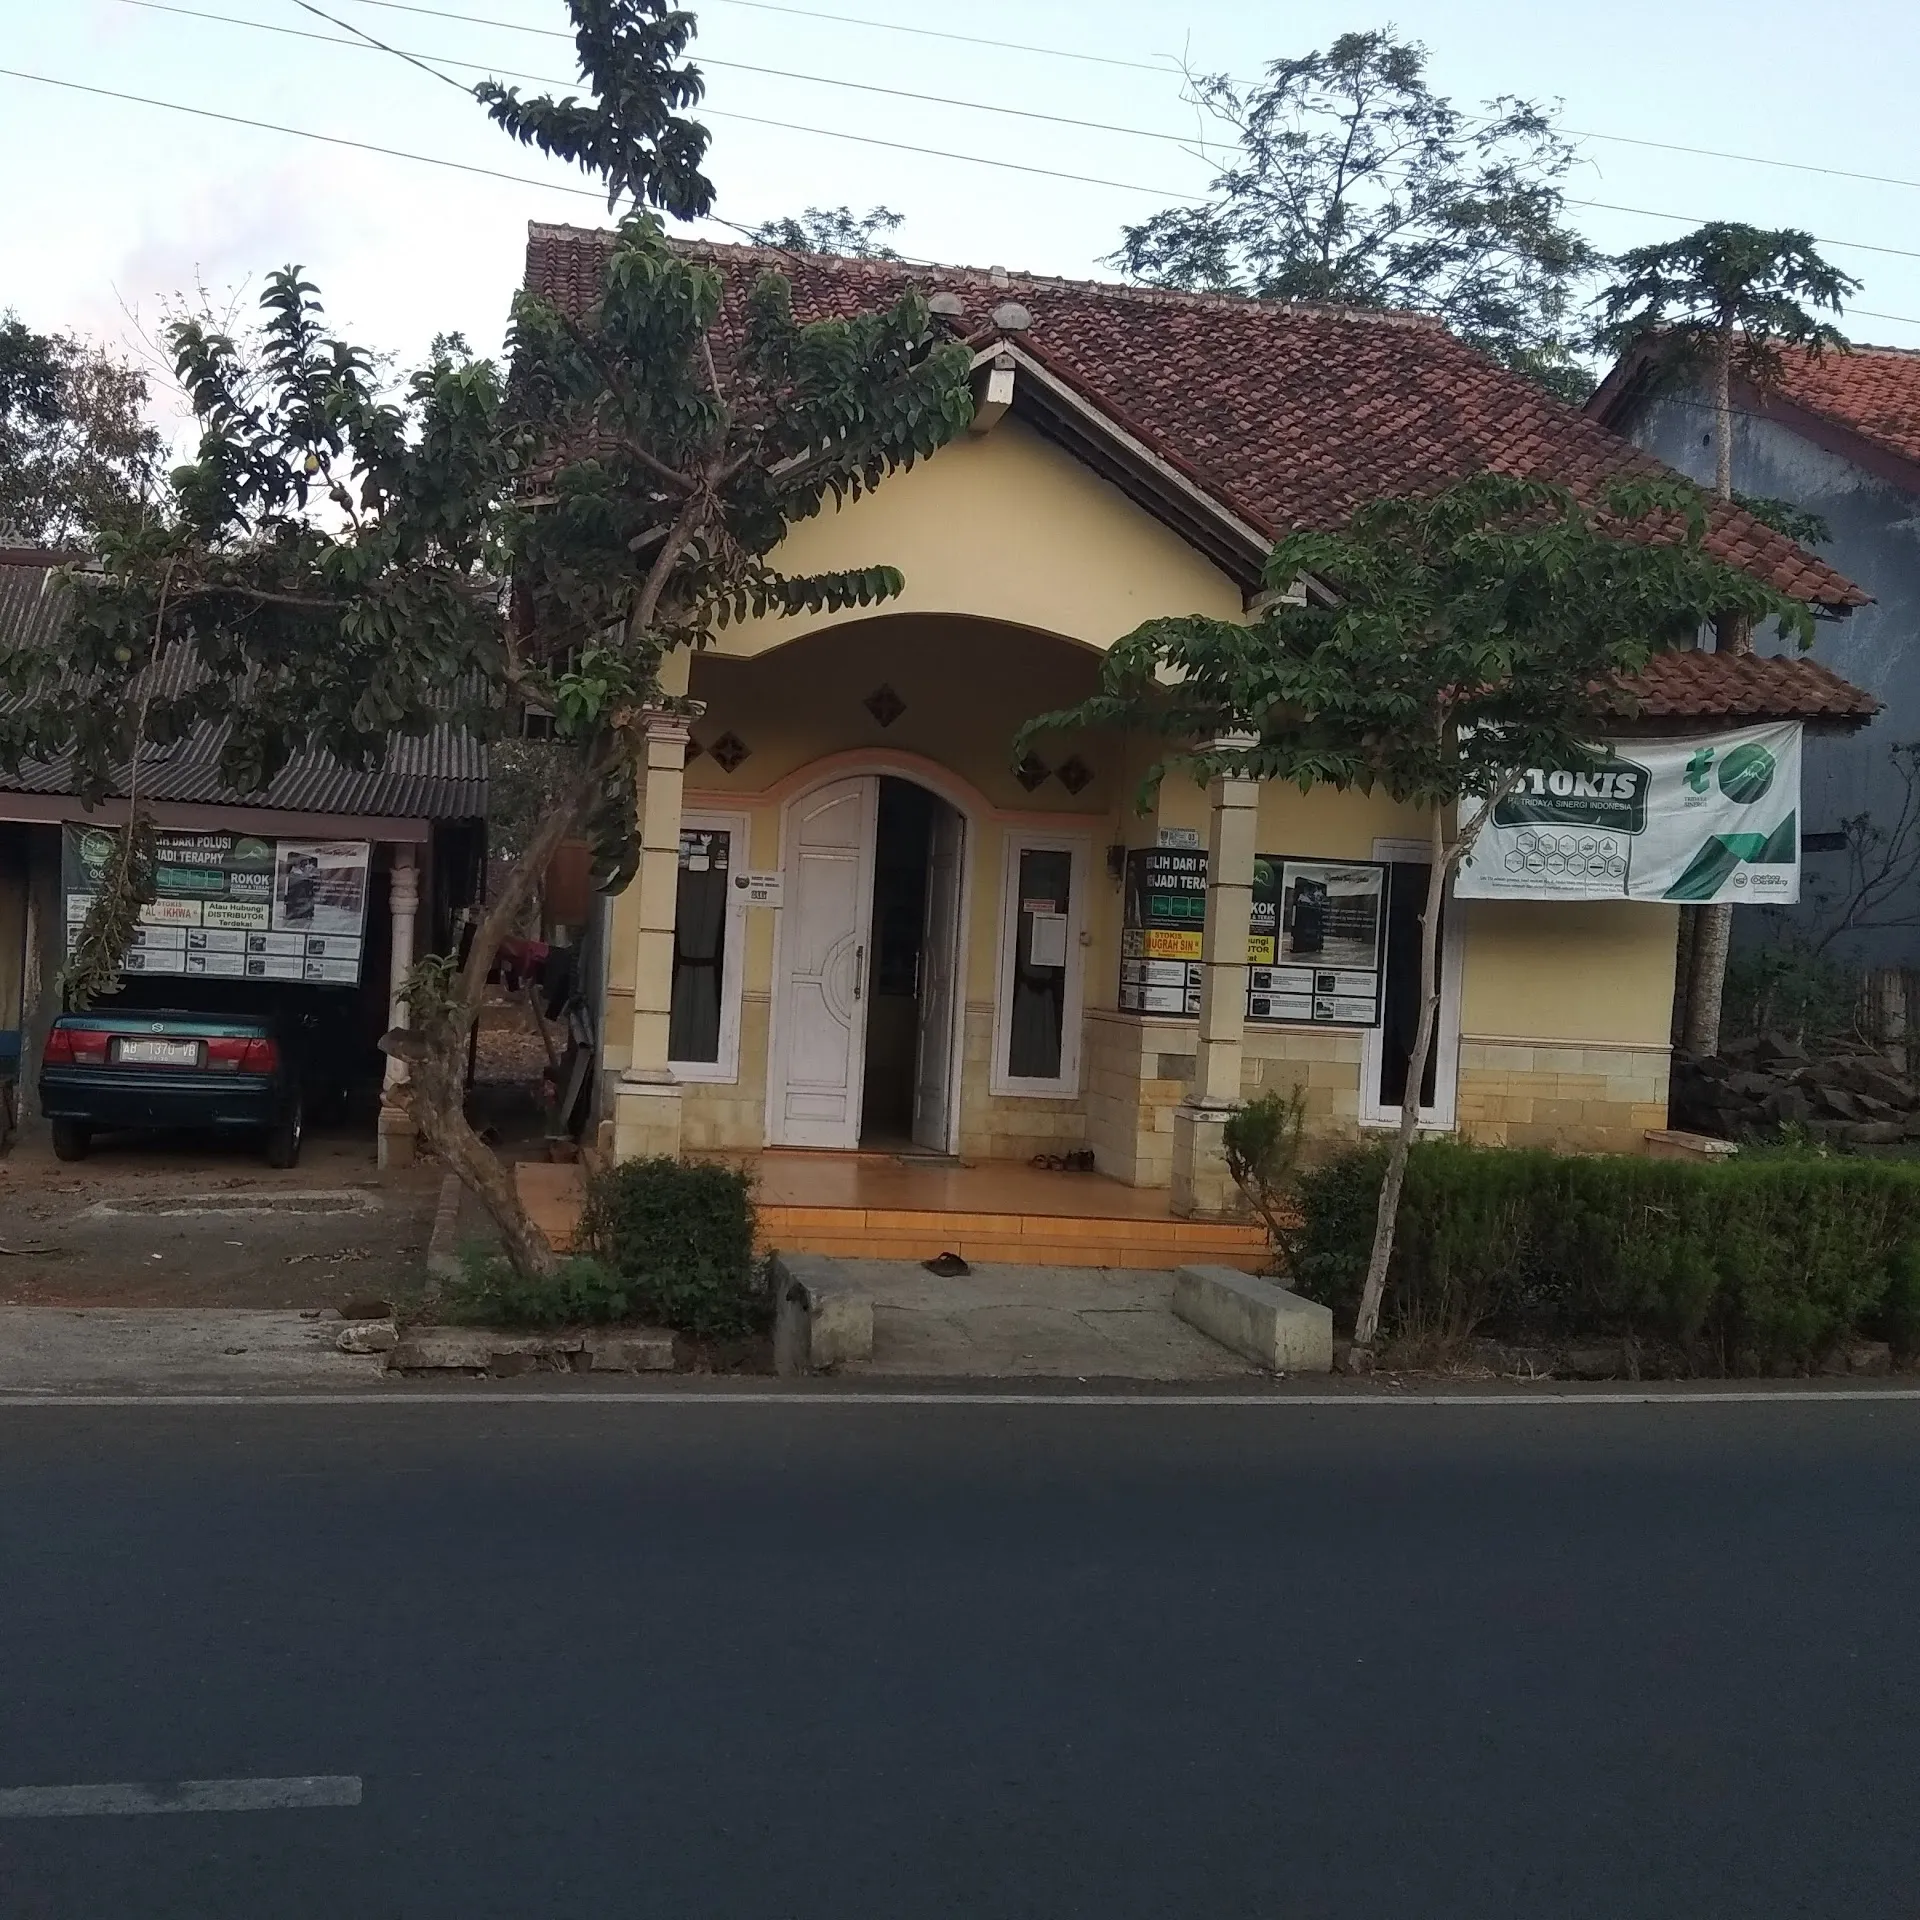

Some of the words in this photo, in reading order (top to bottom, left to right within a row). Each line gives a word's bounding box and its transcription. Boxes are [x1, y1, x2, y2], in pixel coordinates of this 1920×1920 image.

[1520, 798, 1554, 807] TRIDAYA
[1555, 801, 1588, 809] SINERGI
[1589, 802, 1632, 811] INDONESIA
[197, 836, 232, 850] POLUSI
[180, 850, 225, 865] TERAPHY
[1172, 857, 1197, 871] DARI
[230, 873, 270, 886] ROKOK
[1180, 875, 1208, 890] TERA
[230, 904, 264, 913] Hubungi
[207, 911, 264, 921] DISTRIBUTOR
[219, 920, 253, 928] Terdekat
[1154, 931, 1183, 940] STOKIS
[1180, 939, 1194, 951] SIN
[122, 1041, 137, 1054] AB
[149, 1042, 175, 1056] 1370
